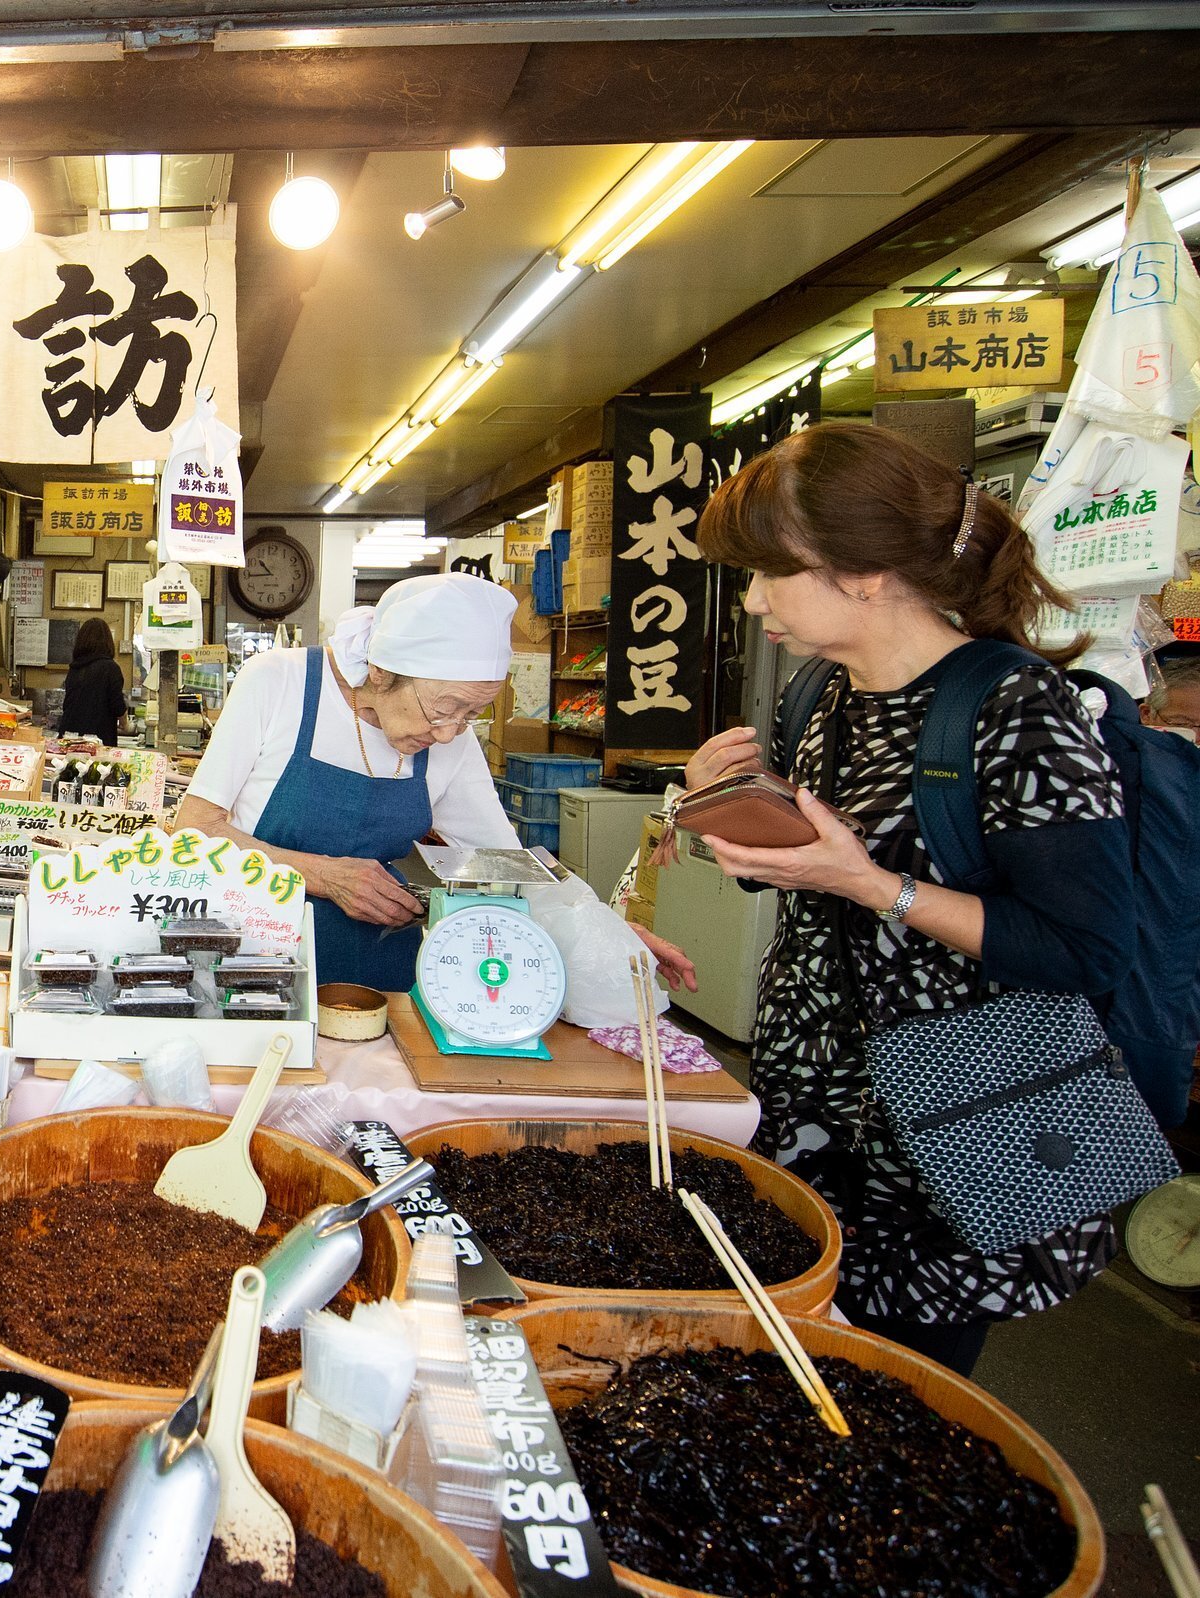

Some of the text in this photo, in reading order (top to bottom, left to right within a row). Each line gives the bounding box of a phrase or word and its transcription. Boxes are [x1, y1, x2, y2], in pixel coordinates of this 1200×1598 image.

[1133, 250, 1168, 302] 5
[926, 306, 1030, 328] 諏訪市場
[13, 254, 199, 437] 訪
[888, 332, 1051, 374] 山本商店
[1135, 349, 1161, 387] 5
[62, 486, 129, 501] 諏訪市場
[50, 510, 144, 533] 諏訪商店
[214, 506, 233, 527] 訪
[1053, 489, 1159, 532] 山本商店
[617, 427, 704, 716] 山本の豆
[923, 769, 952, 778] NIXON
[40, 832, 303, 905] ししゃもきくらげ
[129, 868, 213, 891] しそ風味
[47, 891, 86, 905] プチッと
[72, 904, 121, 918] コリッと!!
[393, 1196, 448, 1214] 200g
[502, 1450, 561, 1476] 00g
[501, 1478, 592, 1525] 600
[523, 1525, 590, 1580] 円
